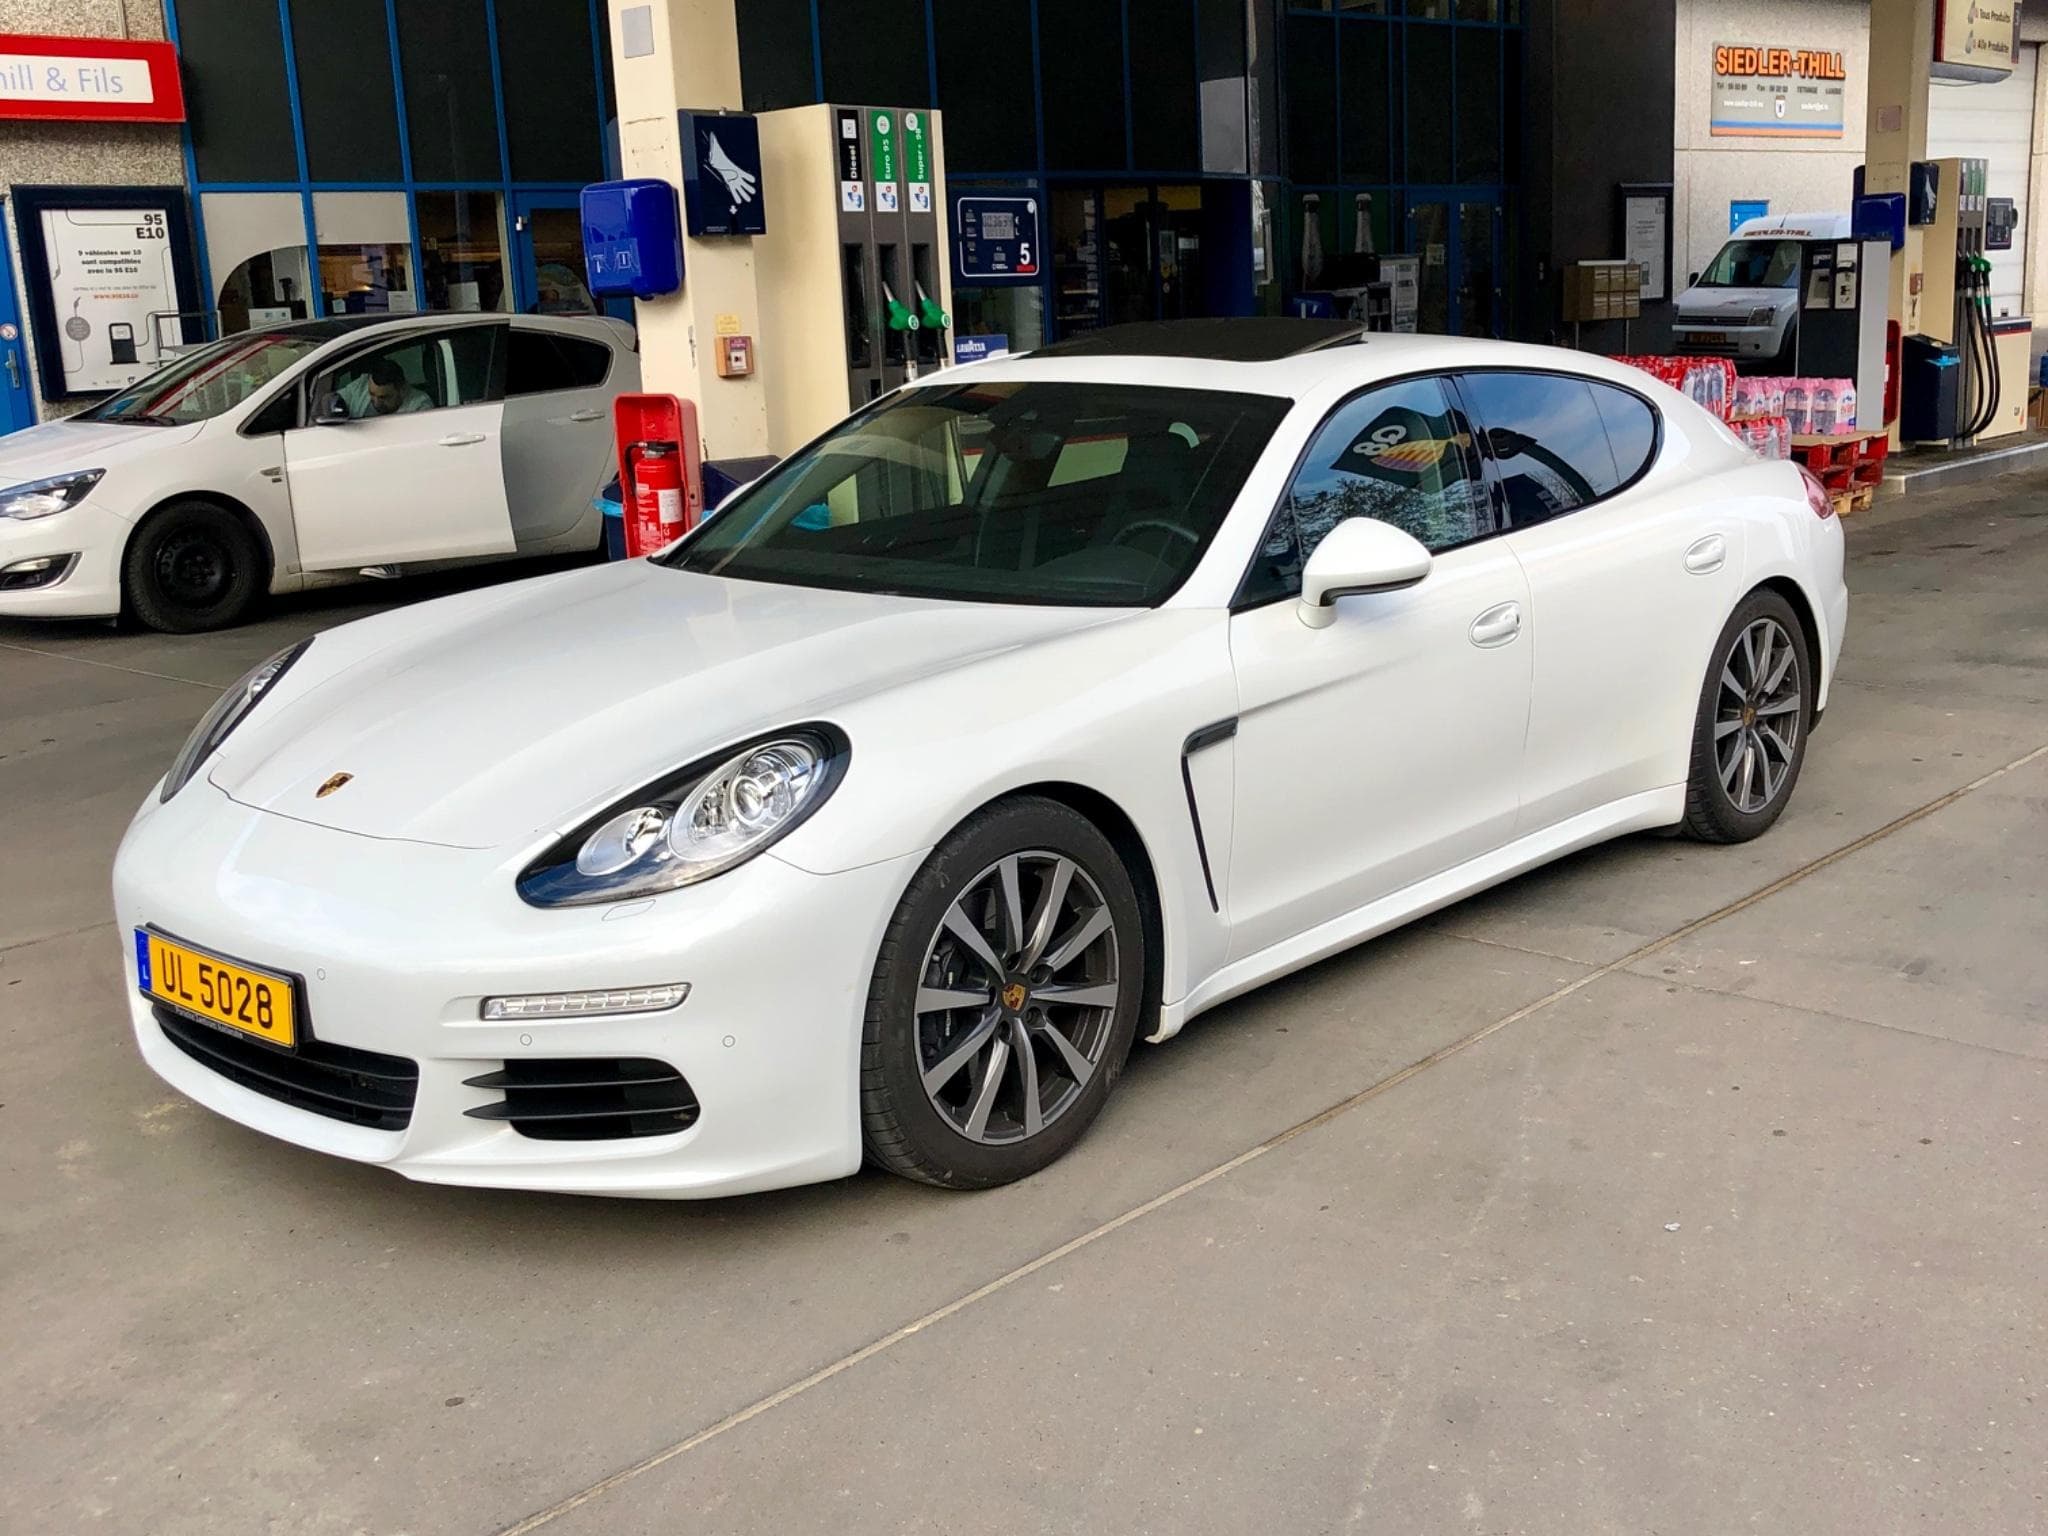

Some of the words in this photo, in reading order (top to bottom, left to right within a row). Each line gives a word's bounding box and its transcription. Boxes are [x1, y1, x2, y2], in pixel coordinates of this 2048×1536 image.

[1715, 46, 1846, 80] SIEDLER-THILL
[47, 67, 68, 92] &
[78, 67, 123, 94] Fils
[882, 138, 890, 152] 95
[848, 145, 858, 179] Diesel
[144, 214, 163, 226] 95
[136, 227, 165, 239] E10
[1020, 243, 1031, 265] 5
[161, 948, 193, 1001] UL
[199, 963, 273, 1030] 5028
